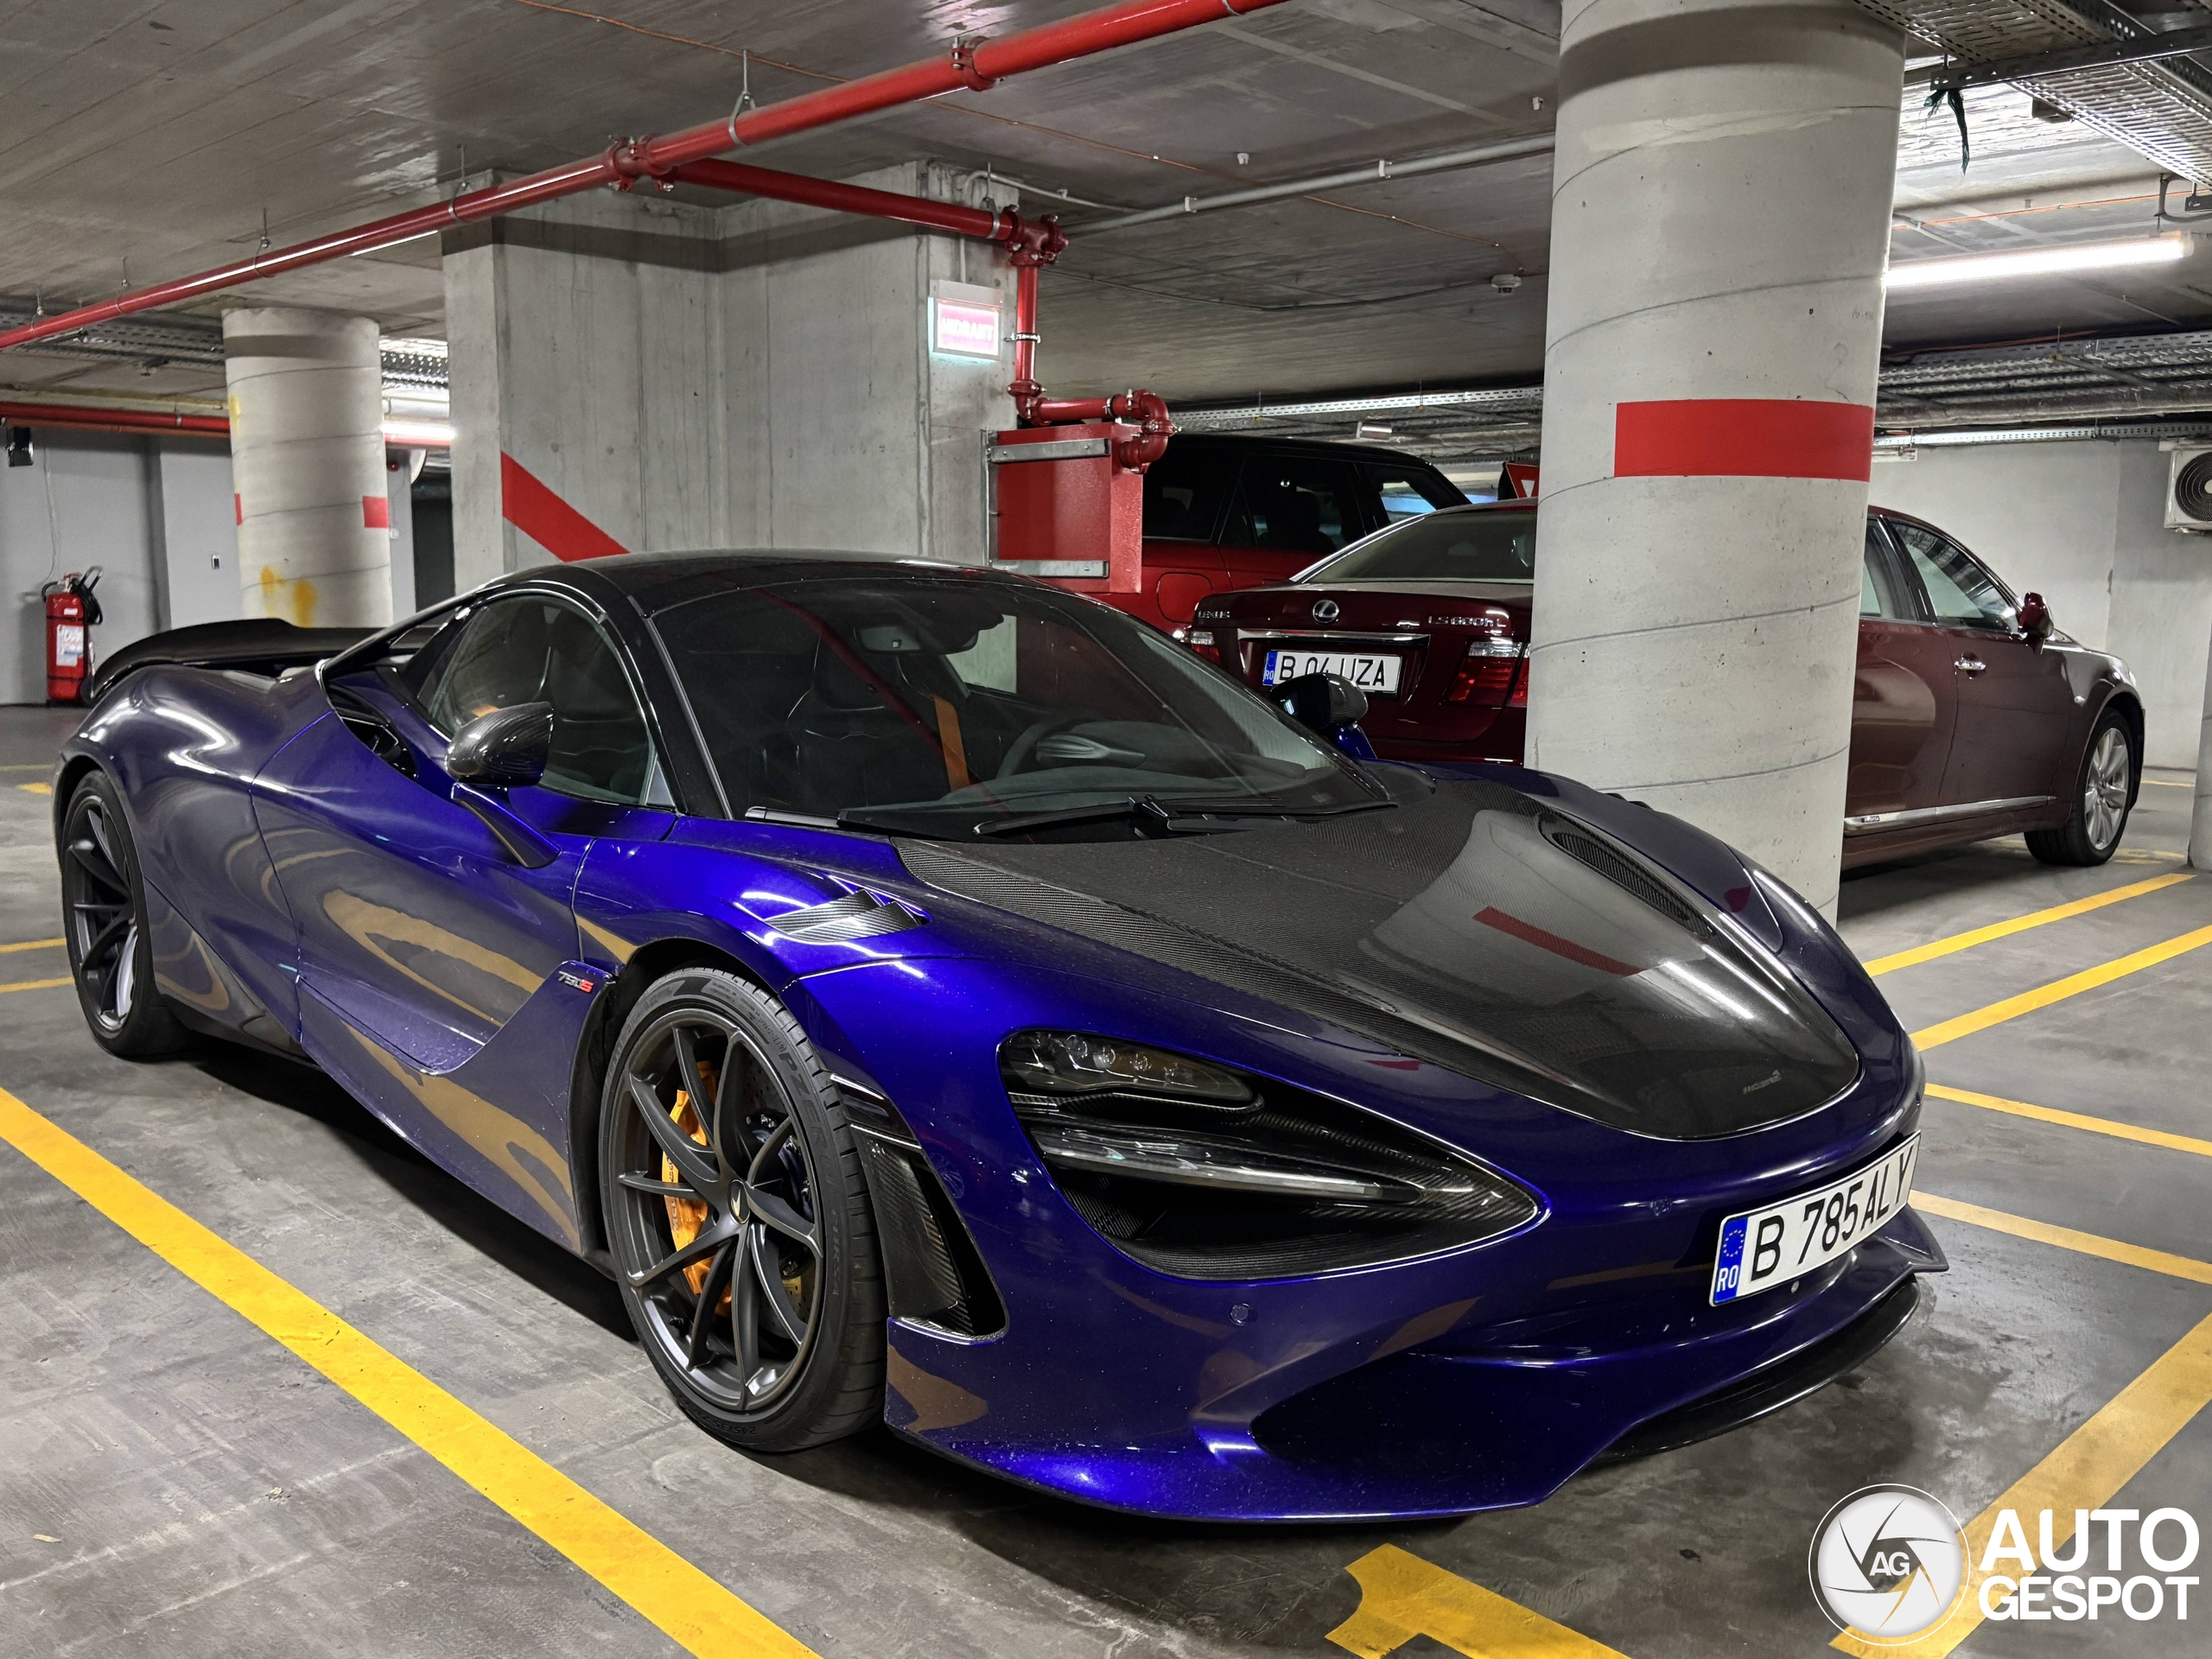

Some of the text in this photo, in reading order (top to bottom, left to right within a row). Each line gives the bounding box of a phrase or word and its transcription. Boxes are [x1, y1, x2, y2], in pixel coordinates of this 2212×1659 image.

[1427, 616, 1449, 625] LS
[1263, 670, 1274, 681] RO
[1279, 655, 1296, 681] B
[1340, 658, 1385, 687] UZA
[1751, 1144, 1915, 1282] B 785 ALY
[1715, 1264, 1739, 1293] RO
